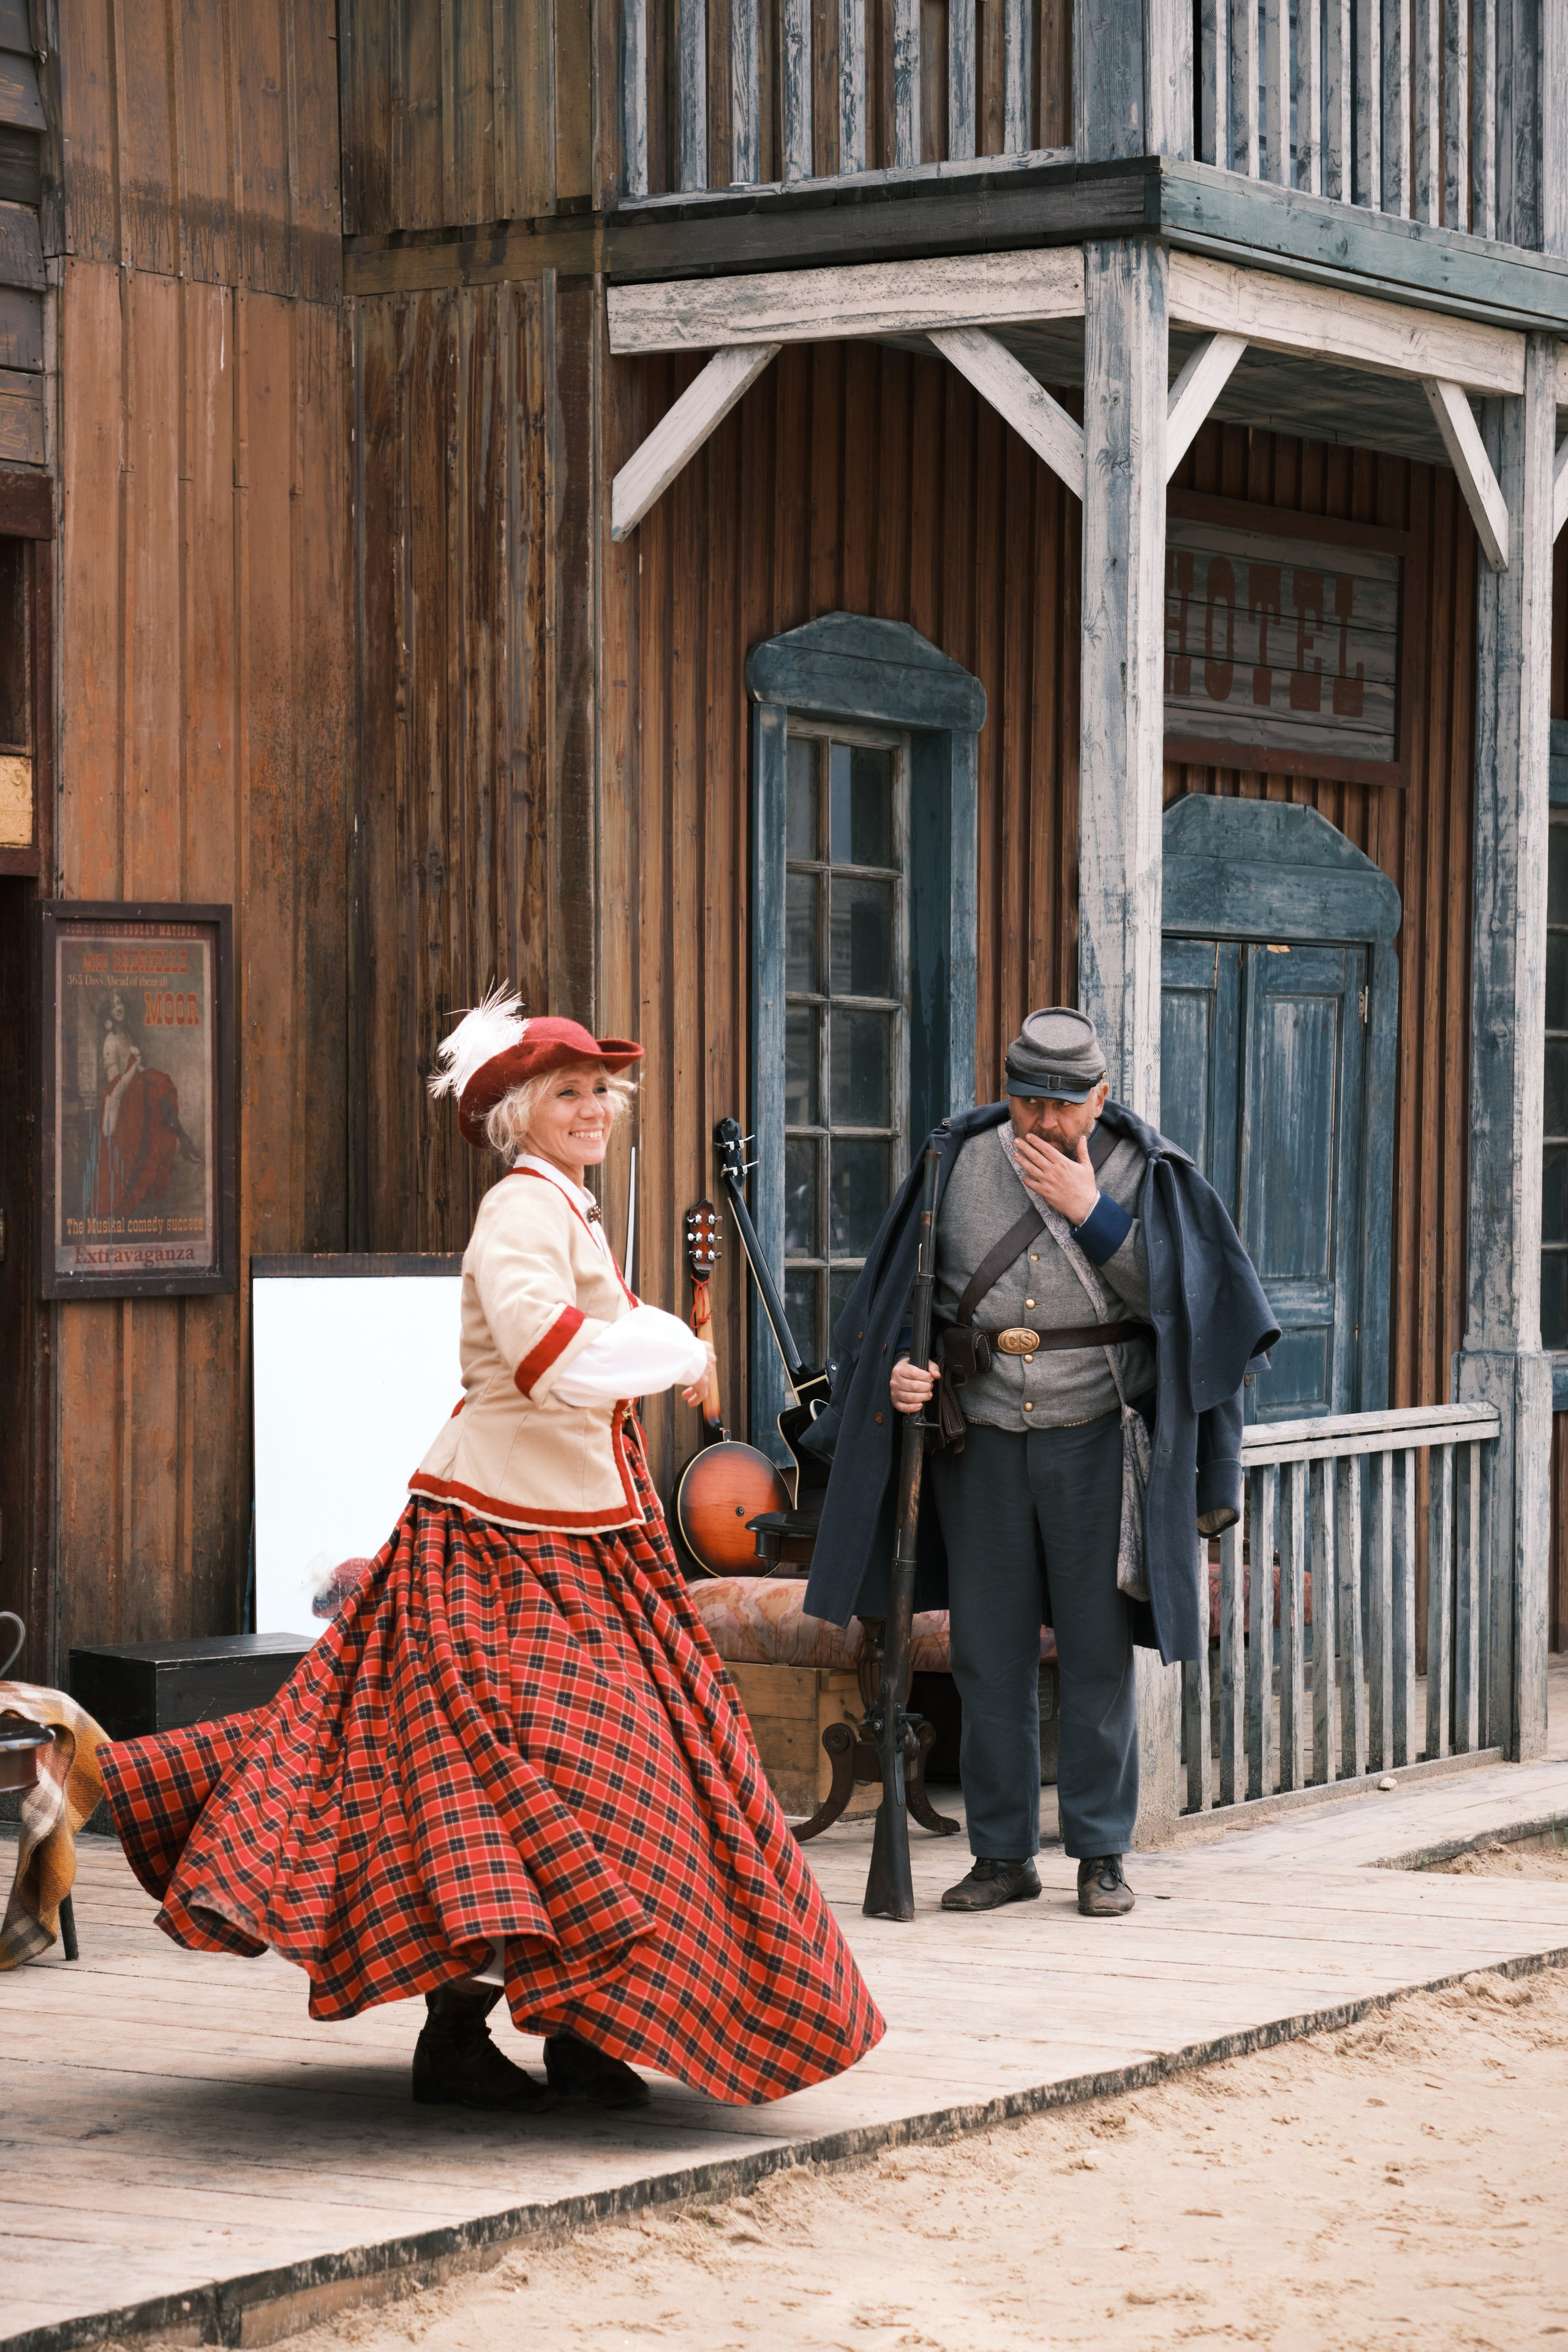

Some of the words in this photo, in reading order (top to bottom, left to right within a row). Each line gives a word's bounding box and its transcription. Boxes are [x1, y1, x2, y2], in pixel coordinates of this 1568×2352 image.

[1164, 549, 1364, 717] HOTEL
[66, 924, 119, 936] Commencing
[124, 924, 155, 935] SUNDAY
[159, 925, 197, 937] MATINEE
[113, 949, 187, 974] GABRIELLE
[67, 974, 83, 986] 365
[85, 974, 104, 987] Days
[106, 975, 129, 986] Ahead
[130, 975, 138, 986] of
[139, 976, 158, 987] them
[159, 976, 168, 987] all
[145, 992, 200, 1027] MOOR
[67, 1218, 83, 1234] The
[87, 1216, 124, 1234] Musikal
[127, 1216, 164, 1234] comedy
[167, 1217, 203, 1232] success
[74, 1245, 195, 1267] Extravaganza
[1005, 1333, 1033, 1349] CS
